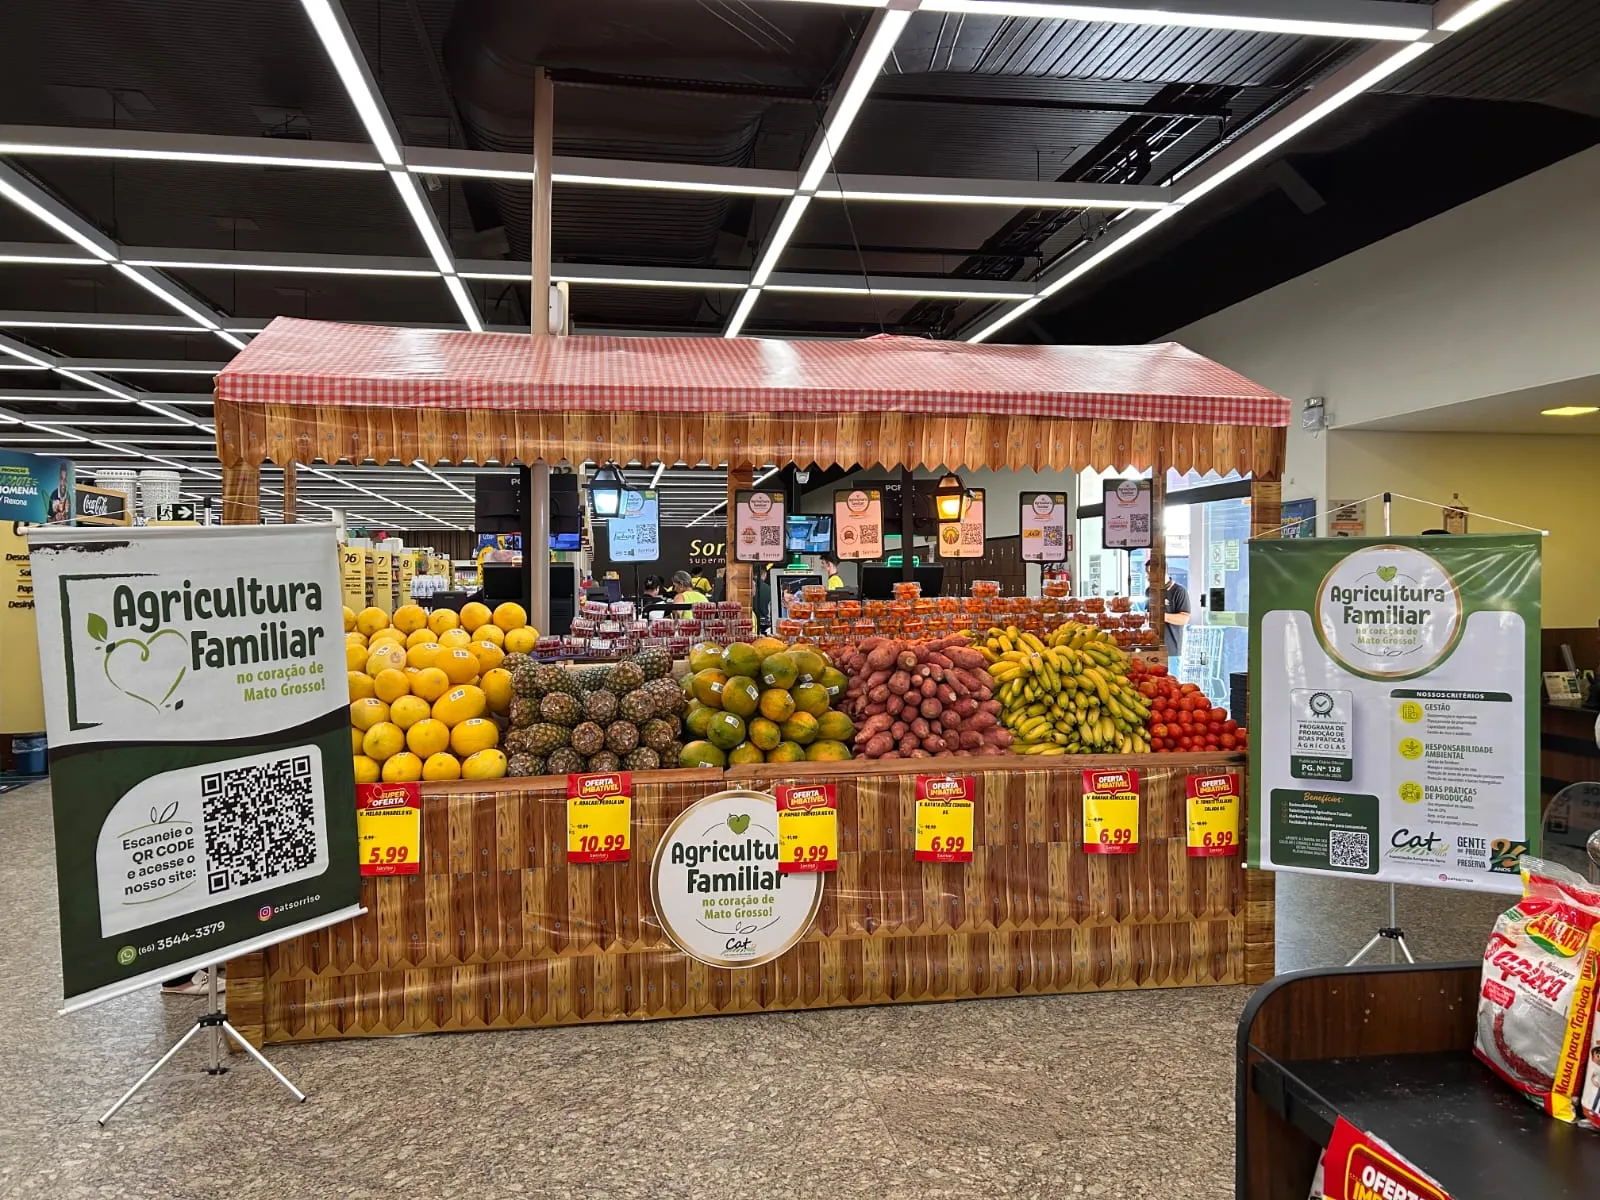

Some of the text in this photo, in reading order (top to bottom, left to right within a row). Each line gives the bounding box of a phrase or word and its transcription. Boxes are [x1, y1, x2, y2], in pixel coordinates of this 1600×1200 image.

[378, 556, 384, 564] 7
[402, 560, 410, 568] 8
[1330, 585, 1445, 604] Agricultura
[114, 577, 322, 633] Agricultura
[1344, 605, 1431, 625] Familiar
[190, 620, 324, 670] Familiar
[1358, 636, 1380, 644] Mato
[236, 661, 324, 684] no coração de
[244, 678, 326, 702] Mato Grosso!
[1424, 702, 1451, 712] GESTÃO
[1424, 750, 1464, 760] AMBIENTAL
[1425, 744, 1494, 754] RESPONSABILIDADE
[585, 778, 613, 786] OFERTA
[932, 782, 958, 790] OFERTA
[1098, 775, 1124, 783] OFERTA
[1201, 779, 1226, 787] OFERTA
[380, 791, 405, 799] SUPER
[793, 790, 819, 798] OFERTA
[372, 798, 404, 806] OFERTA
[122, 826, 193, 850] Escaneie o
[580, 834, 625, 853] 10.99
[931, 836, 965, 852] 6.99
[1100, 829, 1132, 844] 6.99
[1203, 831, 1233, 846] 6.99
[1392, 828, 1442, 851] Cat
[1458, 836, 1486, 849] GENTE
[132, 838, 194, 864] QR CODE
[369, 846, 408, 864] 5.99
[794, 845, 828, 862] 9.99
[128, 855, 196, 879] e acesse o
[1457, 859, 1486, 868] PRESERVA
[125, 869, 196, 896] nosso site:
[687, 866, 788, 894] Familiar
[274, 894, 321, 914] catsorriso
[702, 894, 775, 908] no coração de
[704, 906, 773, 920] Mato Grosso!
[138, 920, 226, 956] (66) 3544-3379
[726, 938, 752, 950] Cat
[1554, 985, 1591, 1096] Massa para Tapioca
[1362, 1166, 1425, 1200] OFERT
